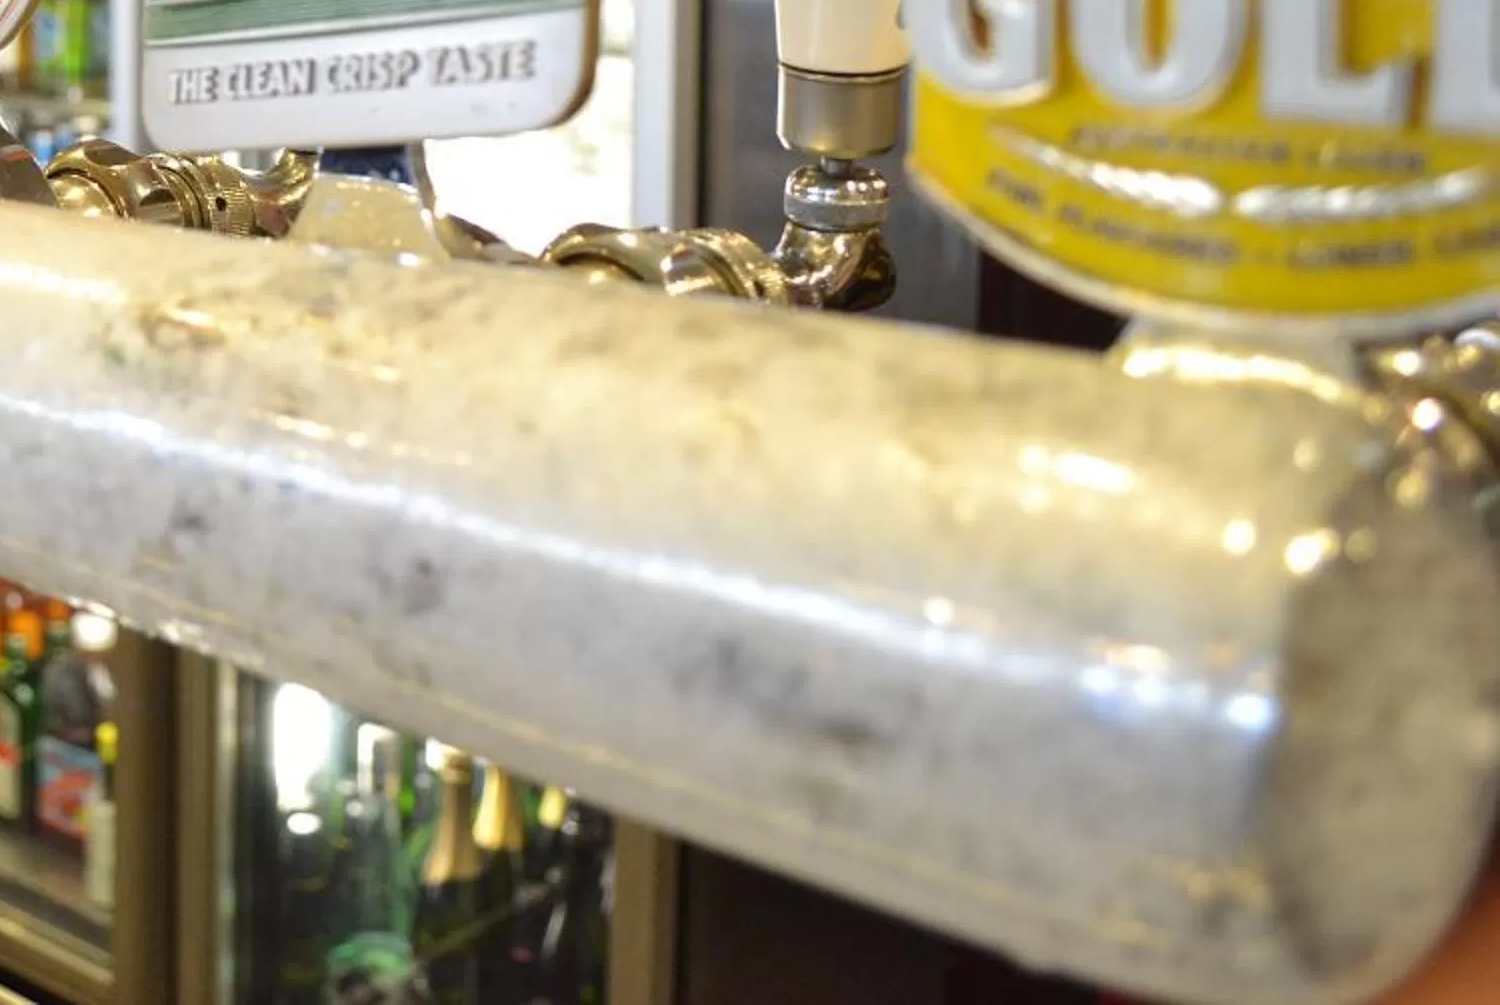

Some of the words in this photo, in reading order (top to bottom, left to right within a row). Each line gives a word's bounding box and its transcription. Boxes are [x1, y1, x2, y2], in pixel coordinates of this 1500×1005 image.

[169, 66, 220, 106] THE
[227, 56, 318, 101] CLEAN
[326, 49, 422, 94] CRISP
[426, 39, 538, 87] TASTE
